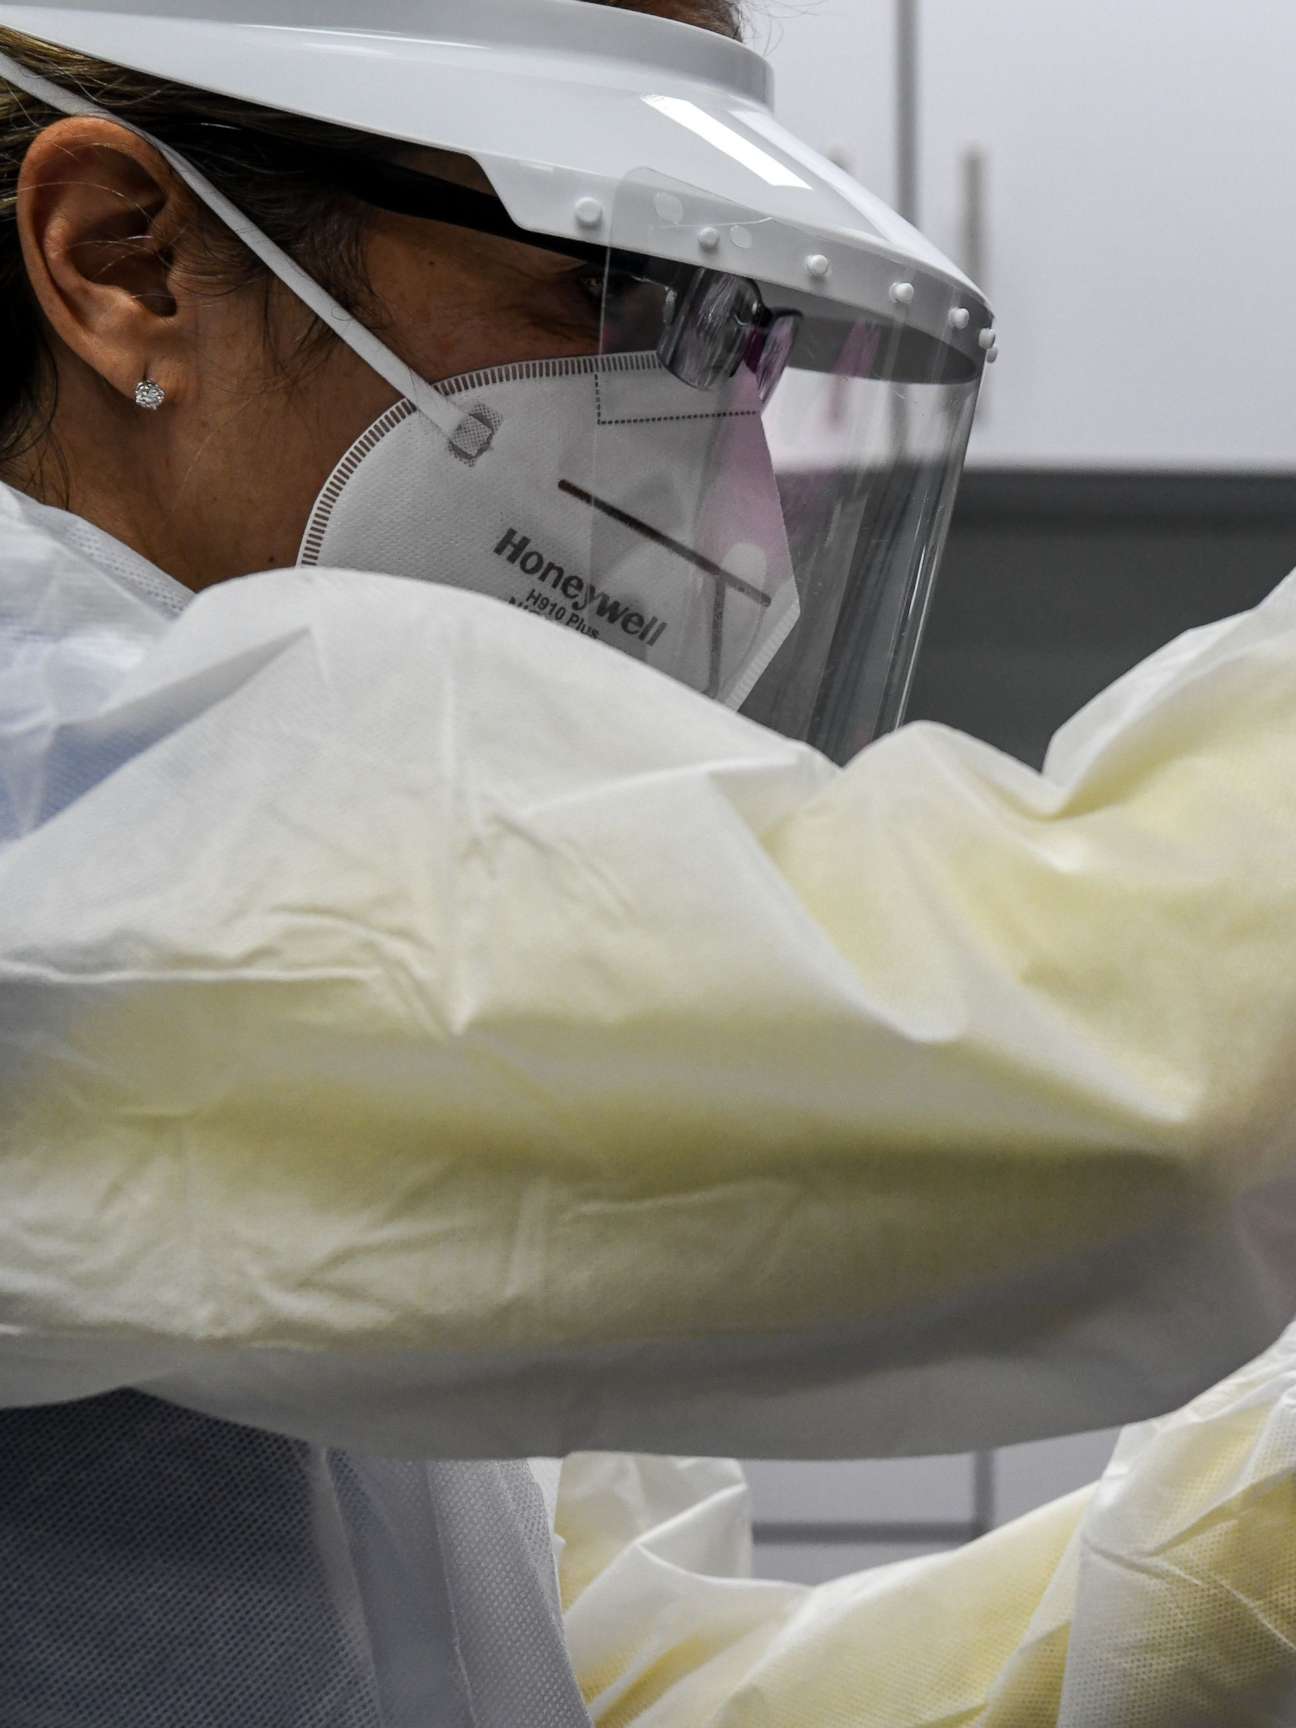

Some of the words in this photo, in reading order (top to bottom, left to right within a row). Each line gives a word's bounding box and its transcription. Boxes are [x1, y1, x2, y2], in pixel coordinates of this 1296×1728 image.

[493, 527, 668, 647] Honeywell
[526, 588, 566, 621] H910
[566, 612, 600, 640] Plus
